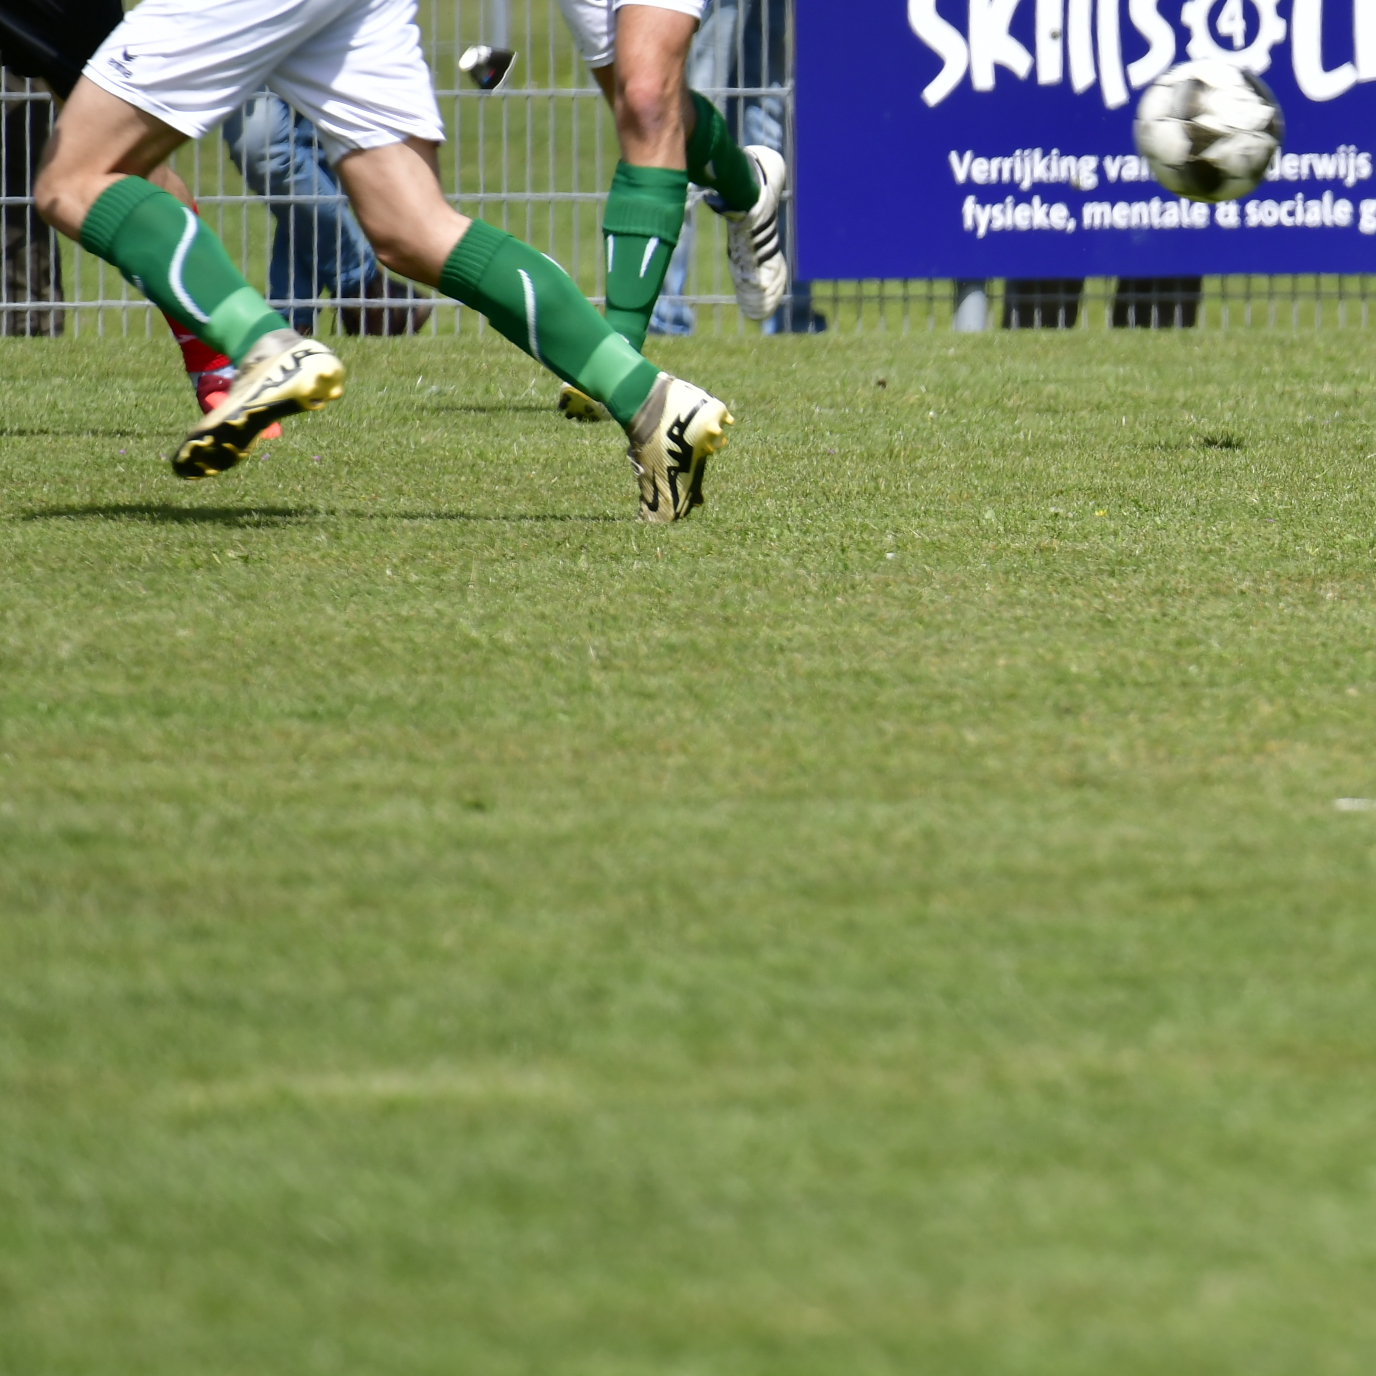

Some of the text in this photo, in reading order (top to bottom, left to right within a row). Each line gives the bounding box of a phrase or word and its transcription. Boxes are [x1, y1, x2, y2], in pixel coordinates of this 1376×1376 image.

[948, 147, 1099, 192] Verrijking
[1266, 143, 1373, 188] derwijs
[962, 194, 1077, 240] fysieke,
[1082, 195, 1211, 230] mentale
[1214, 198, 1242, 230] &
[1244, 189, 1354, 228] sociale
